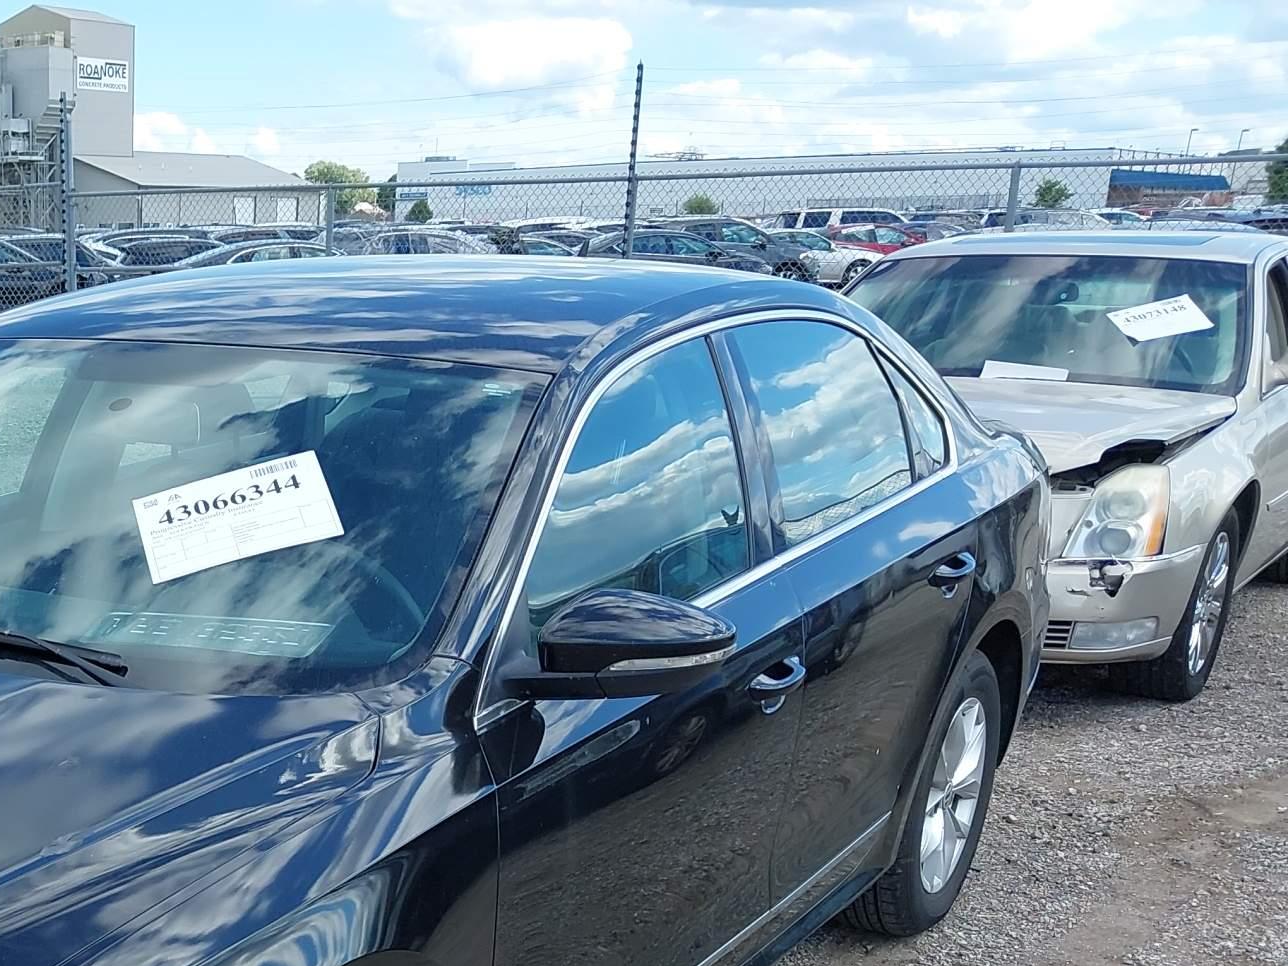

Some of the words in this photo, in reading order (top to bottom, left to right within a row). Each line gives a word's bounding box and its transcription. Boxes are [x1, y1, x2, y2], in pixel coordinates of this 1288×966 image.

[79, 62, 127, 80] ROANOKE
[78, 81, 102, 89] CONCRETE
[1123, 304, 1188, 323] 43073148
[158, 473, 302, 526] 43066344
